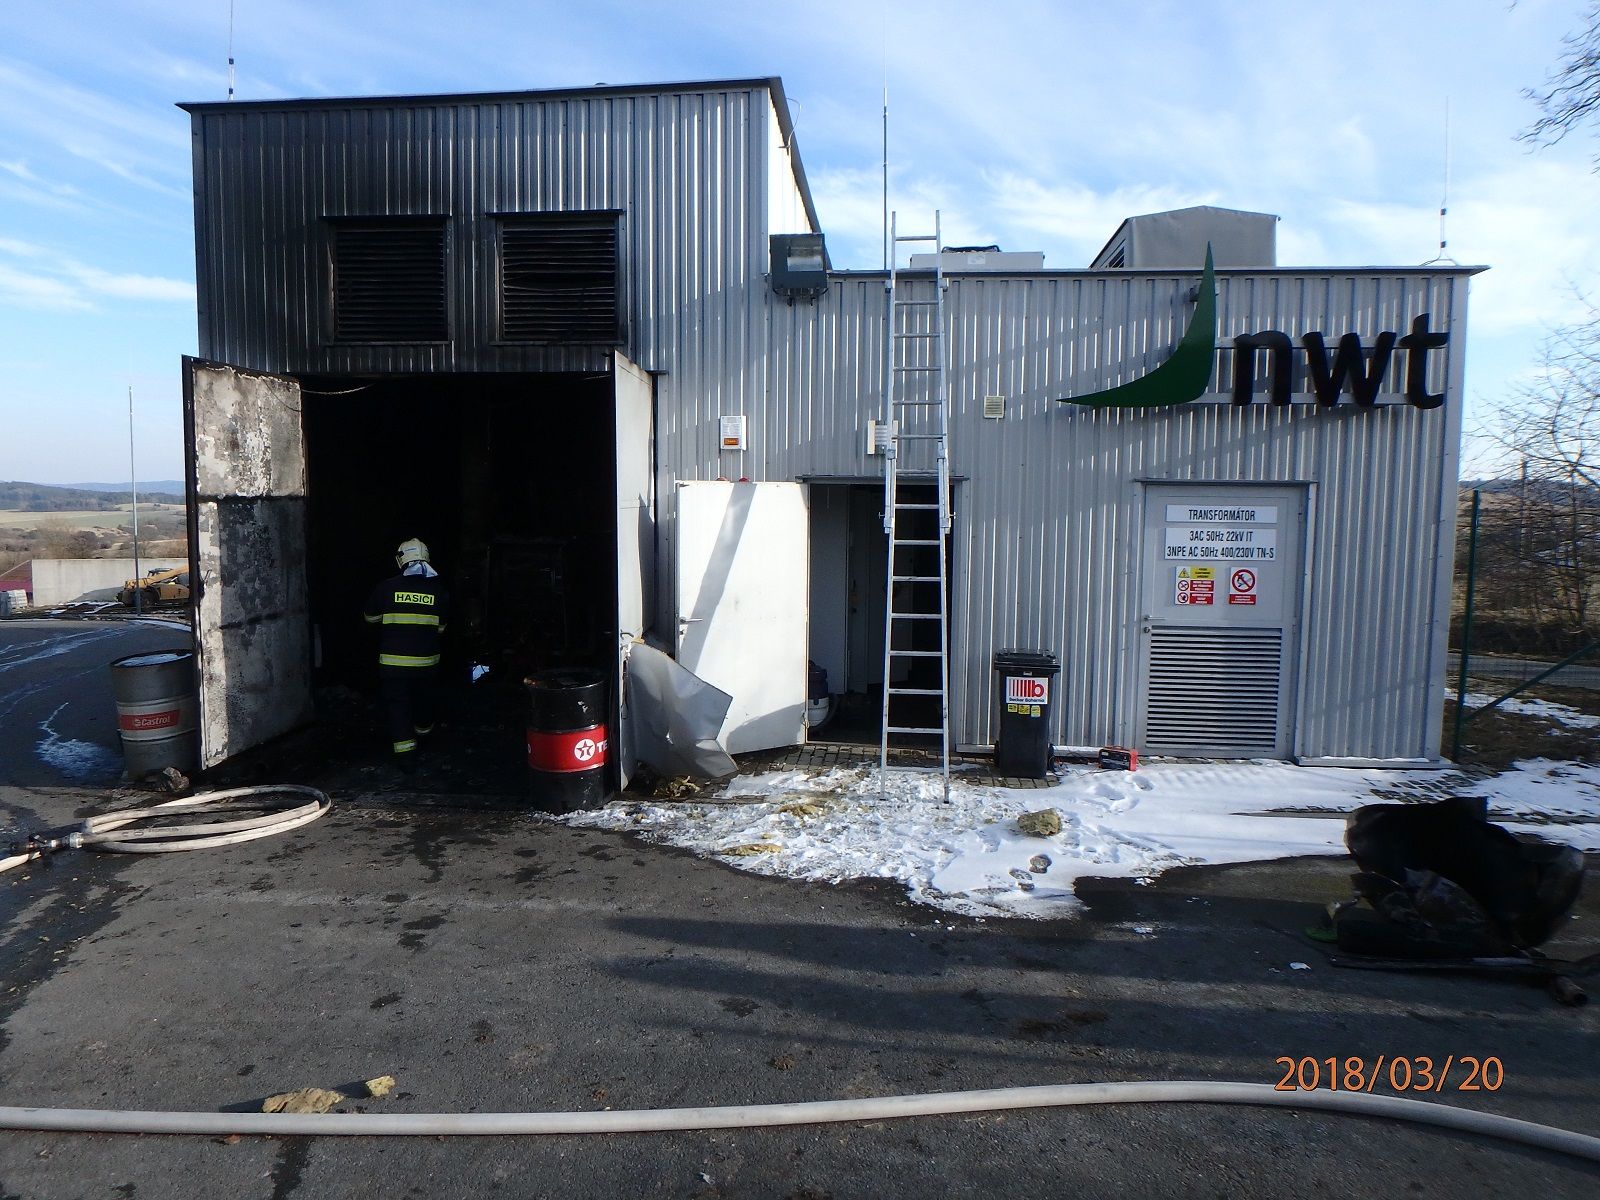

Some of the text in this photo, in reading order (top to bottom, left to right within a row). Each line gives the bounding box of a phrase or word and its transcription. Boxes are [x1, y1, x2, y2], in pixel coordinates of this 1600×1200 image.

[1233, 313, 1449, 409] nwt
[1189, 507, 1256, 521] TRANSFORMÁTOR
[1189, 530, 1253, 542] 3AC 50Hz 22kV IT
[1167, 546, 1274, 559] 3NPE AC 50Hz 400/230V TN-S
[142, 716, 170, 726] Castrol
